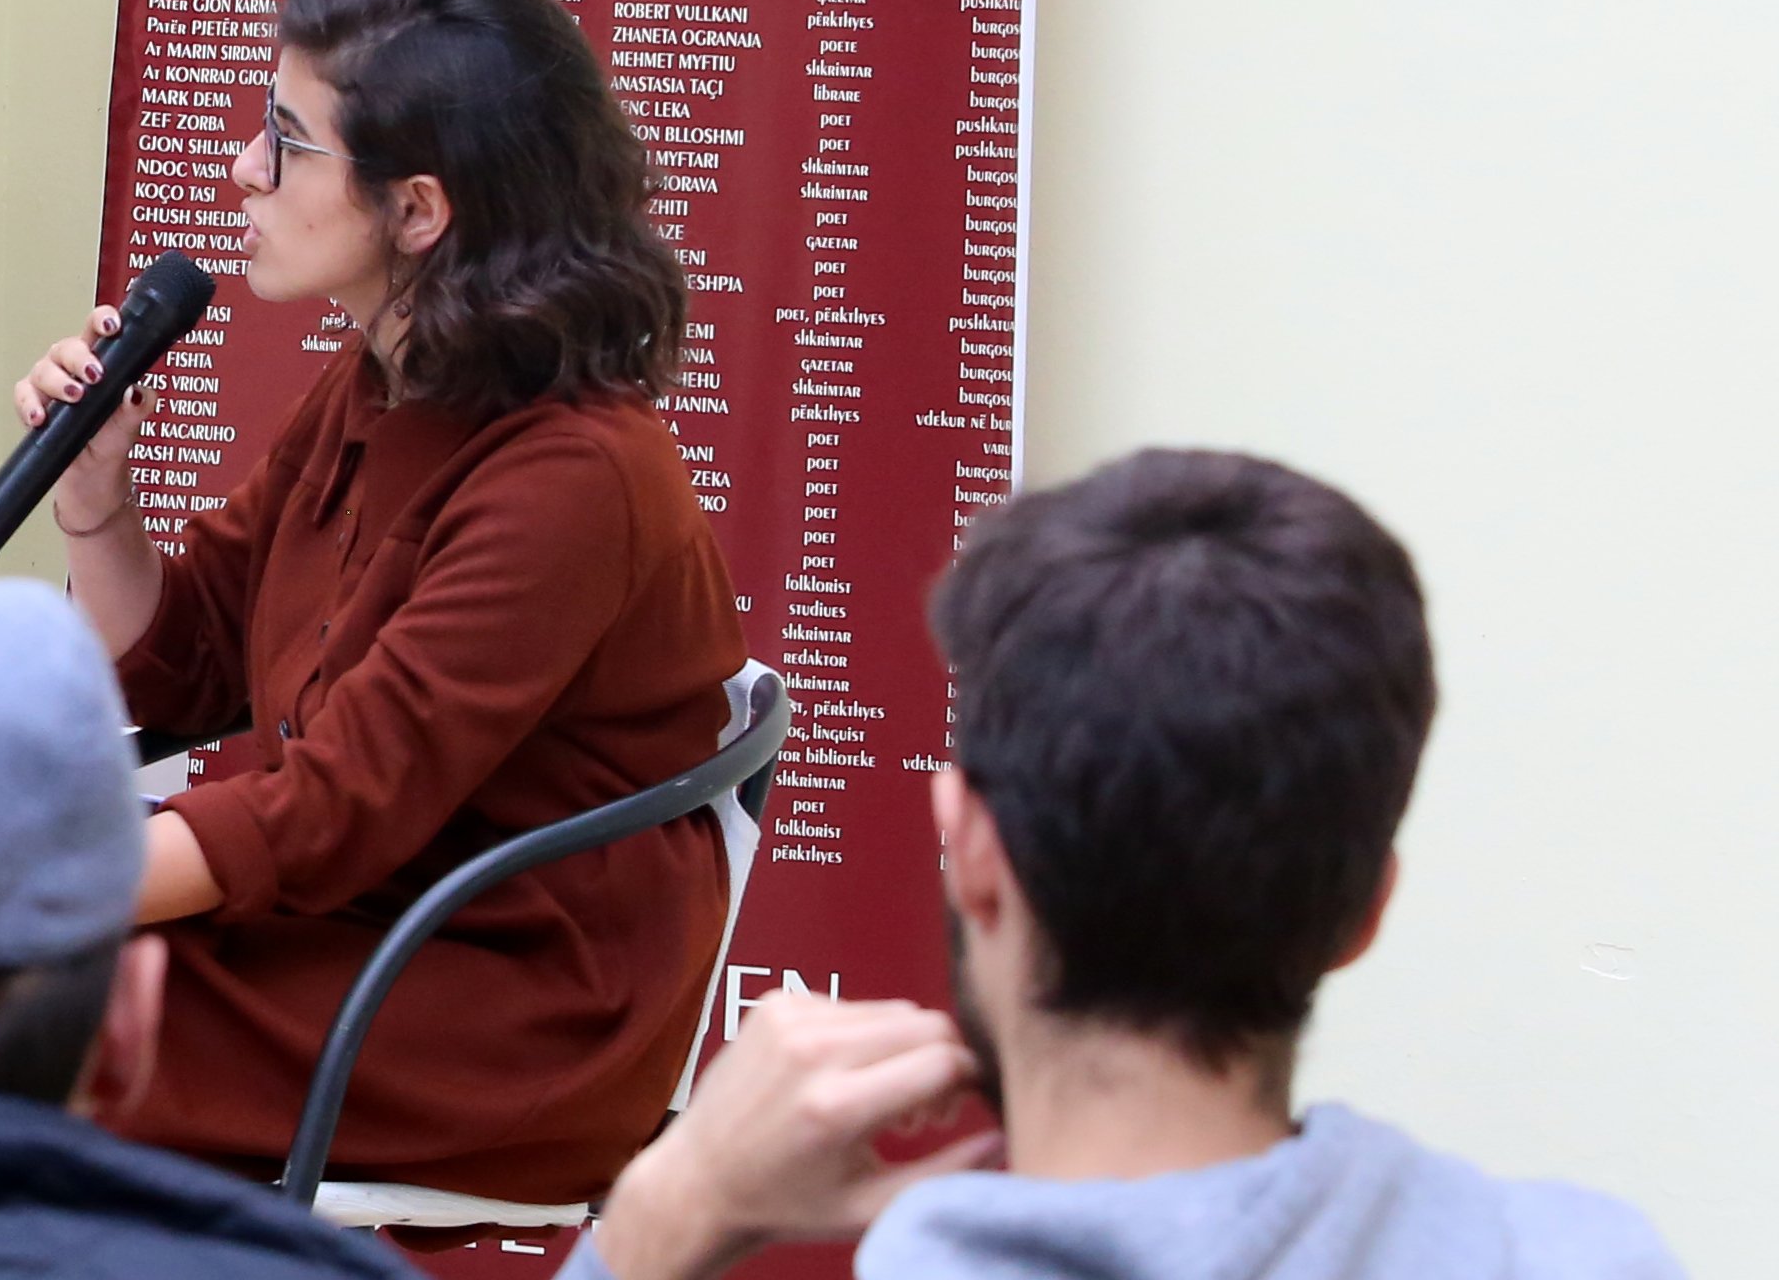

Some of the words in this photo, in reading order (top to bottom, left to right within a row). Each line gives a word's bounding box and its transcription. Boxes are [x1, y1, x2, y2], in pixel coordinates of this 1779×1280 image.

[614, 1, 672, 20] ROBERT
[675, 4, 748, 24] VULLKANI
[611, 50, 675, 69] MEHMET
[678, 53, 736, 72] MYFTIU
[141, 87, 189, 106] MARK
[193, 91, 232, 108] DEMA
[139, 110, 172, 129] ZEF
[176, 113, 225, 132] ZORBA
[690, 469, 731, 488] ZEKA
